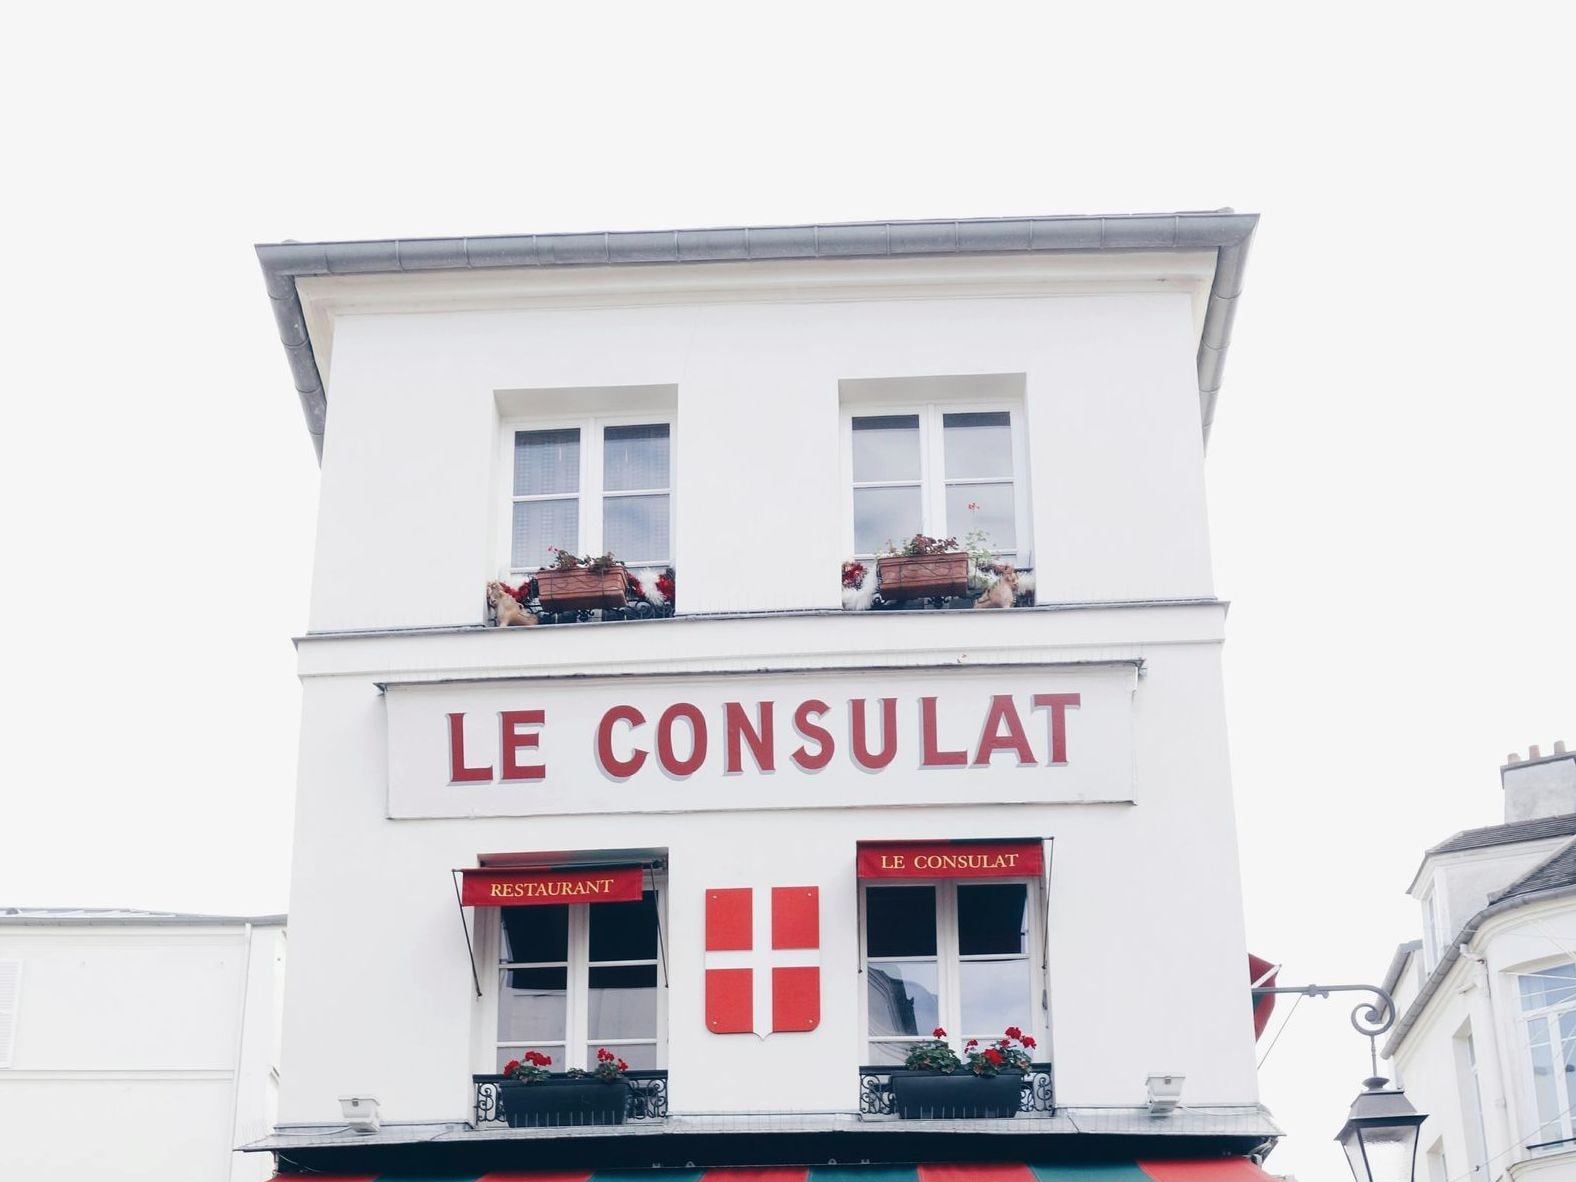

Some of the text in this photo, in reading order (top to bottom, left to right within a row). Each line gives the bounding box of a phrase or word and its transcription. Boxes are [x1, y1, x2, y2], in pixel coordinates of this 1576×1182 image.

[449, 693, 1081, 782] LE CONSULAT
[882, 852, 1019, 870] LE CONSULAT
[490, 879, 614, 897] RESTAURANT
